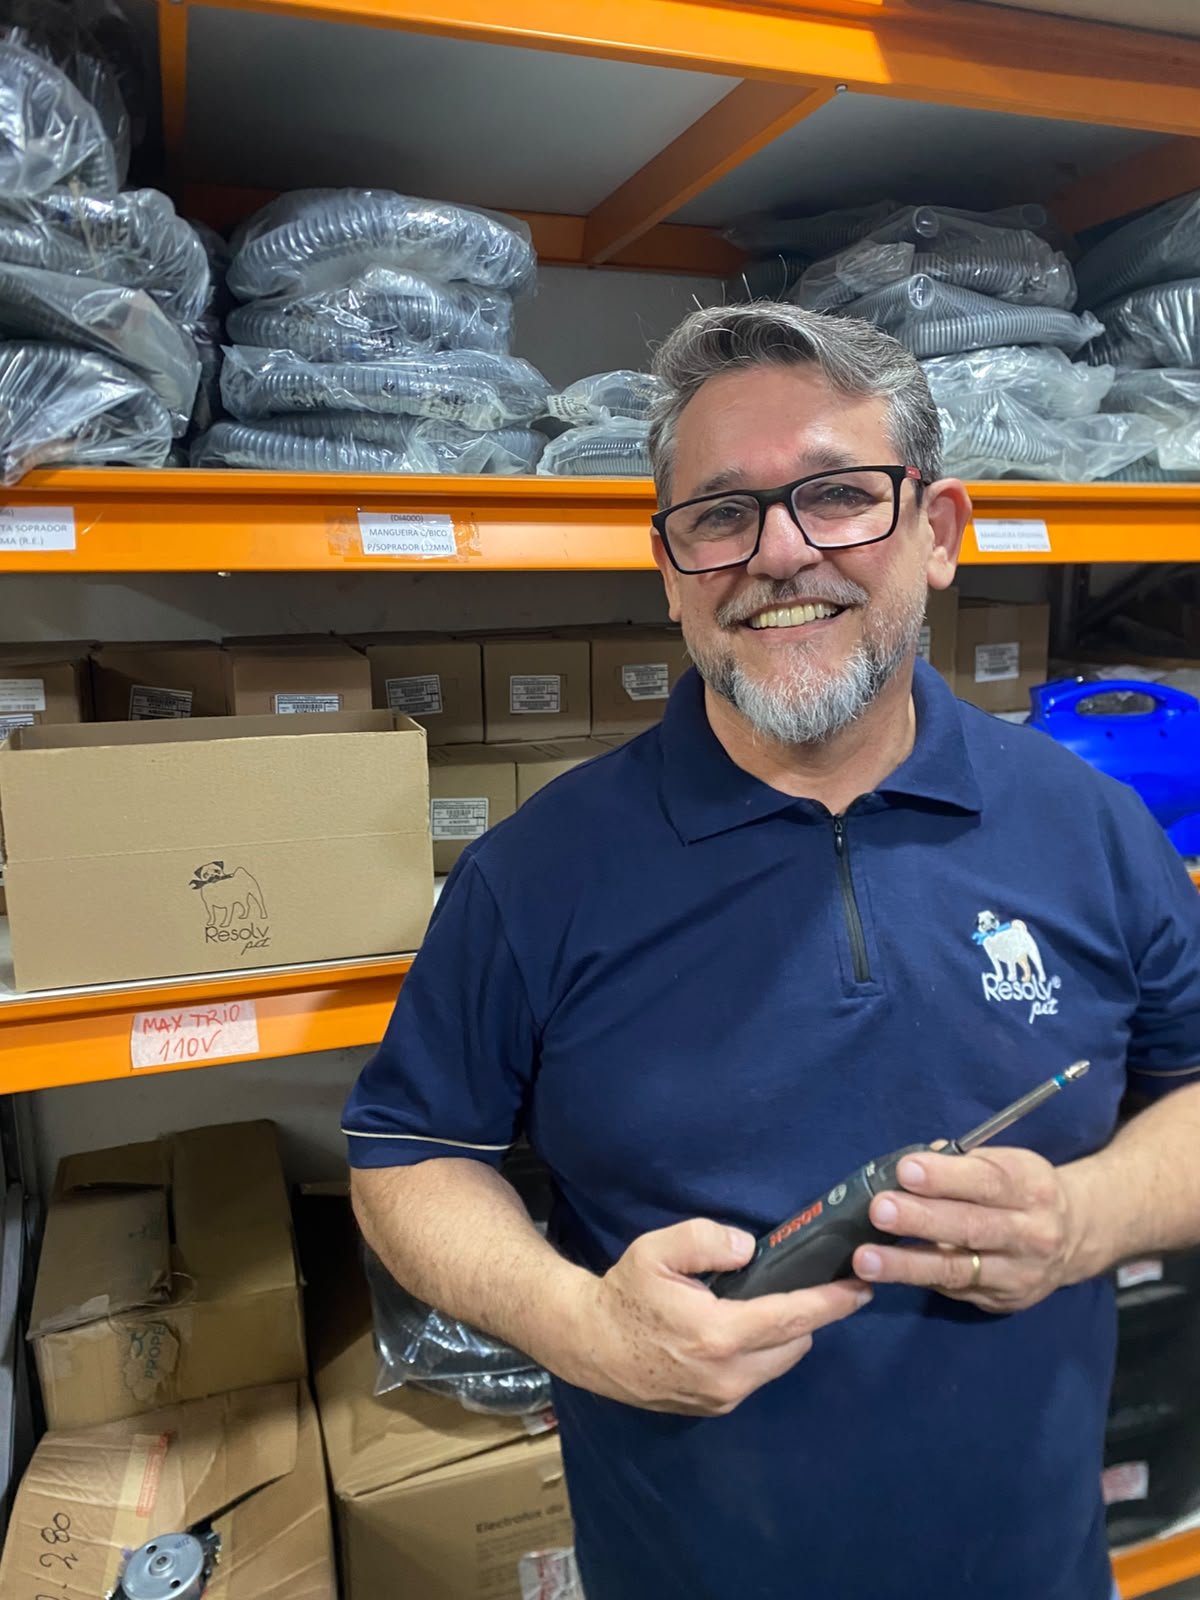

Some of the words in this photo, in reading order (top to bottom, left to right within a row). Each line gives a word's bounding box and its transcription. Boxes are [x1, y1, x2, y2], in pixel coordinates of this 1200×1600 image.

[15, 524, 68, 533] SOPRADOR
[369, 529, 418, 537] MANGUEIRA
[420, 529, 448, 538] C/BICO
[367, 543, 420, 552] P/SOPRADOR
[205, 922, 269, 943] Resolv
[143, 1014, 183, 1035] MAX
[160, 1029, 222, 1062] 110V
[769, 1201, 823, 1248] BOSCH
[40, 1512, 79, 1570] 280
